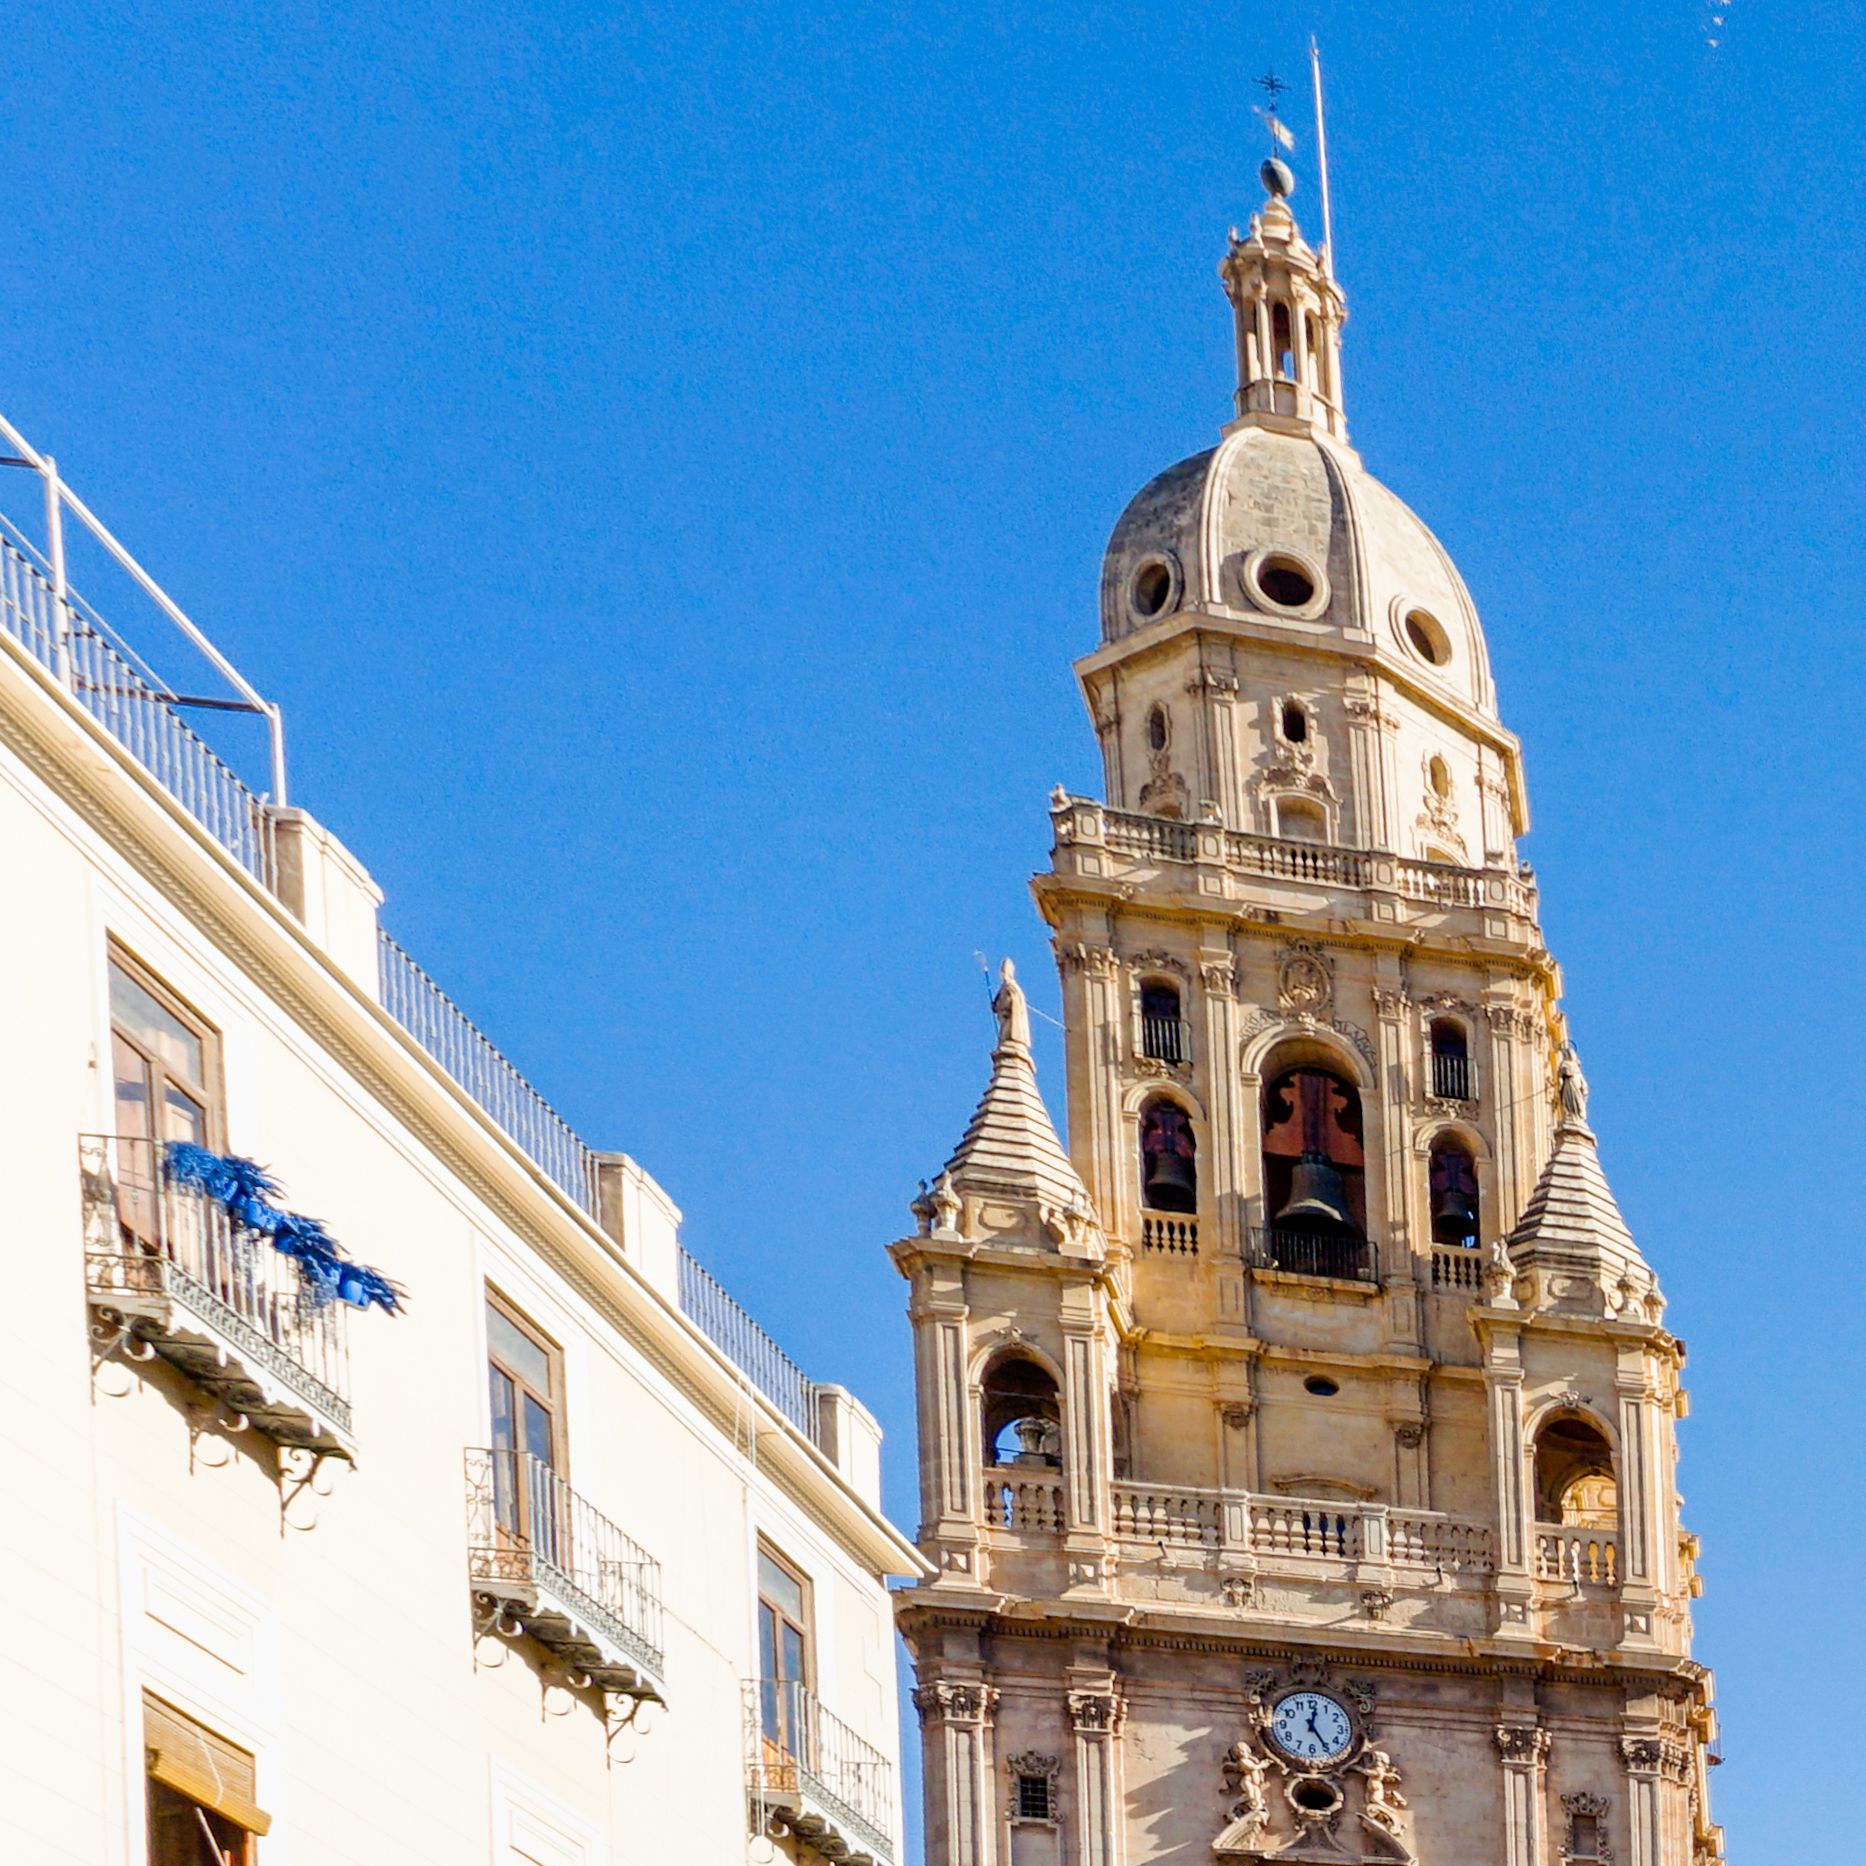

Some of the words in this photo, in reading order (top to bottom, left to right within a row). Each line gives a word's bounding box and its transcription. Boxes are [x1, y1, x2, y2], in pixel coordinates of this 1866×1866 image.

[1296, 1701, 1304, 1711] 11
[1307, 1700, 1318, 1709] 12
[1323, 1705, 1328, 1714] 1
[1284, 1709, 1295, 1719] 10
[1332, 1713, 1339, 1723] 2
[1280, 1720, 1287, 1729] 9
[1337, 1725, 1344, 1735] 3
[1285, 1731, 1292, 1741] 8
[1332, 1736, 1340, 1745] 4
[1296, 1740, 1303, 1750] 7
[1309, 1744, 1316, 1754] 6
[1323, 1743, 1329, 1752] 5
